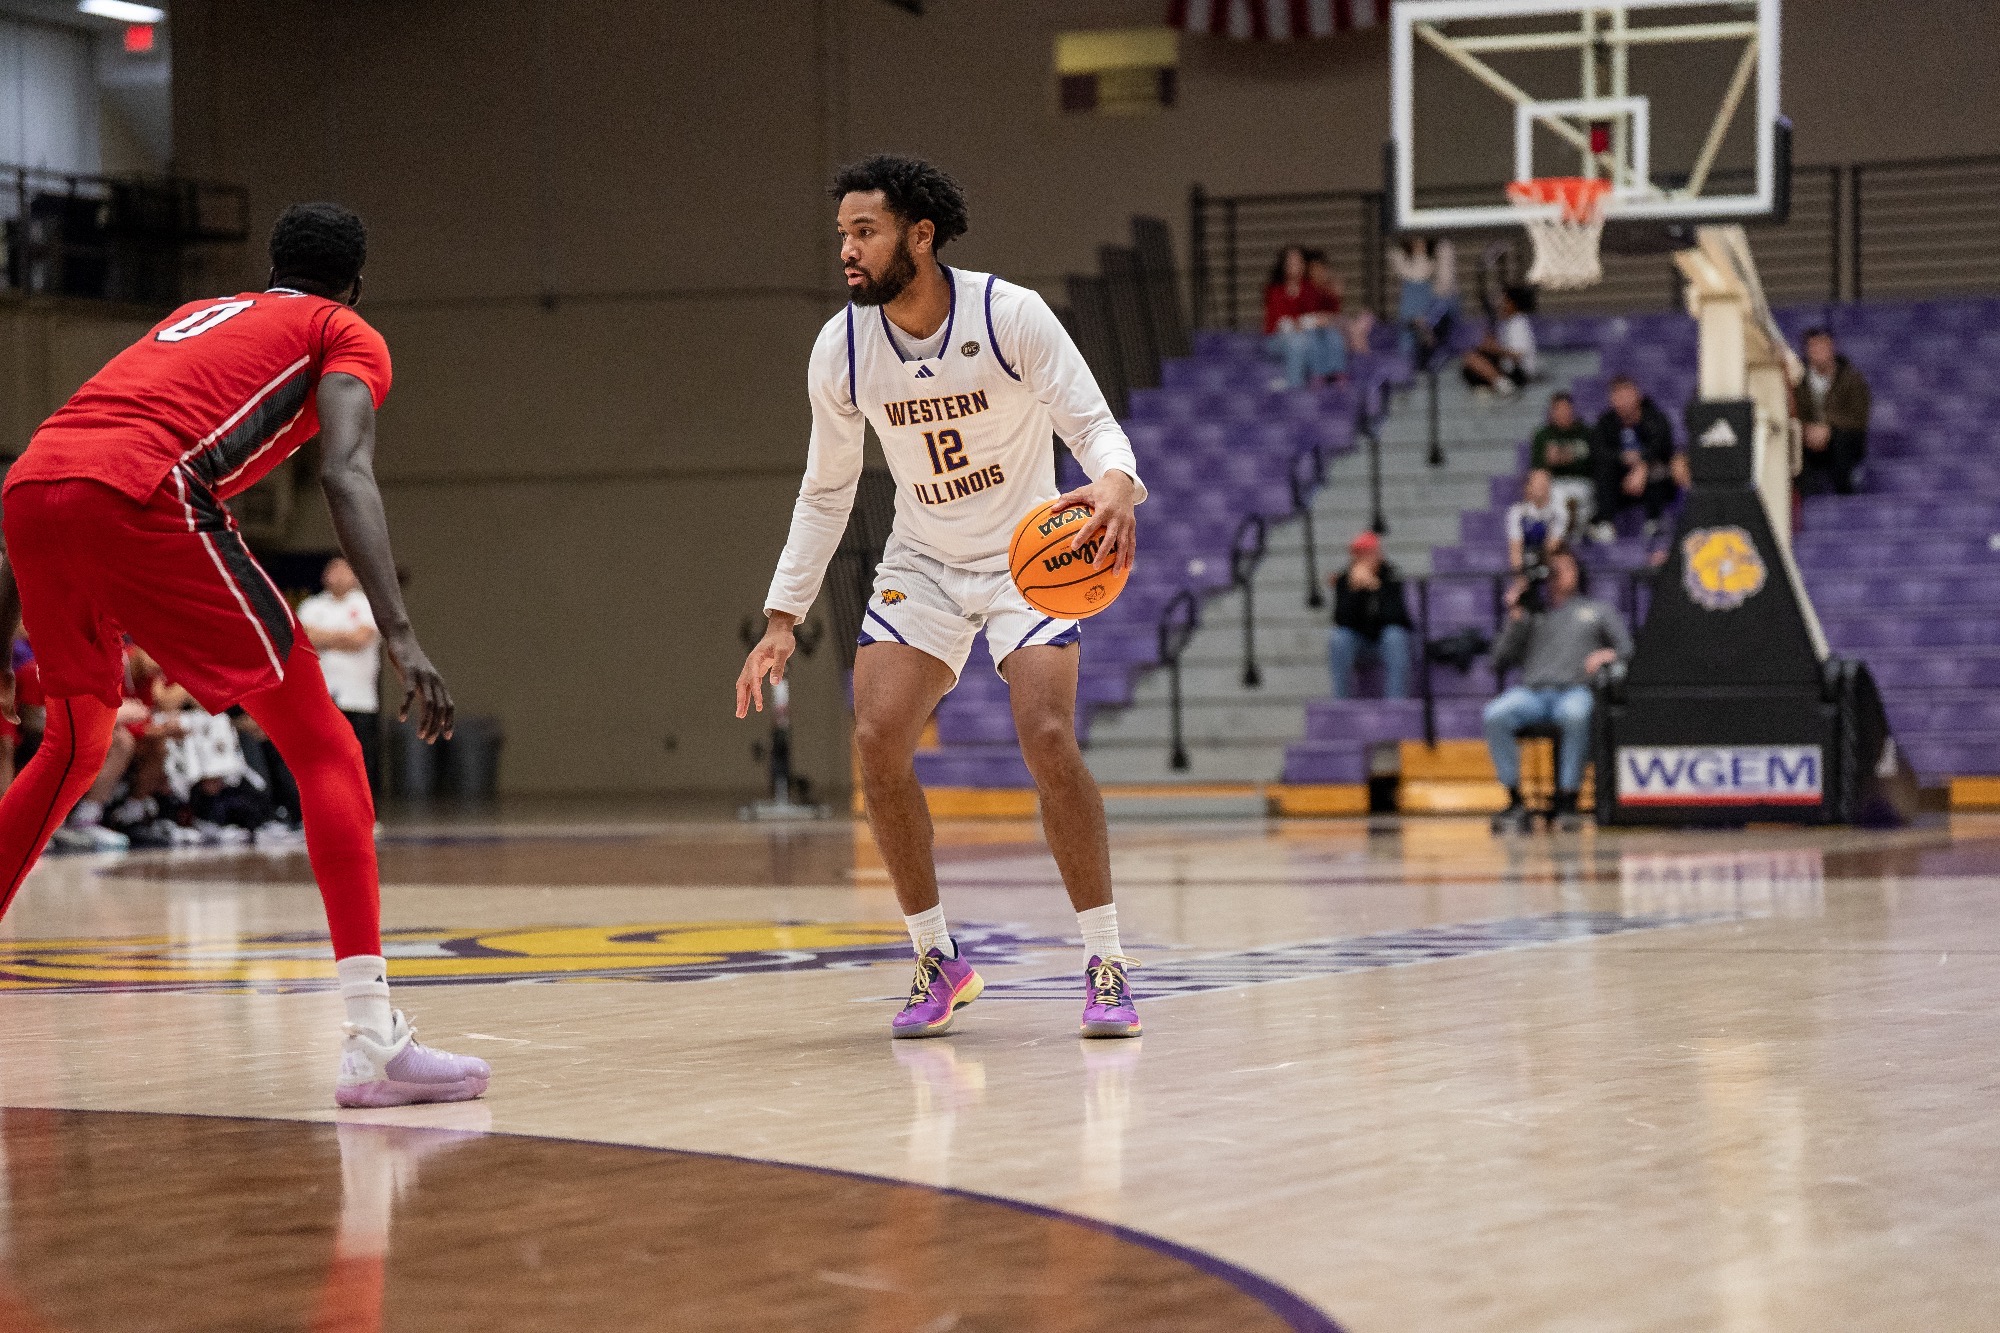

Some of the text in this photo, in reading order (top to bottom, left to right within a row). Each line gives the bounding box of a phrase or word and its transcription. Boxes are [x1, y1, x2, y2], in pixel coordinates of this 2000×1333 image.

[154, 299, 257, 343] 0
[883, 388, 990, 427] WESTERN
[921, 428, 970, 476] 12
[913, 463, 1005, 505] ILLINOIS
[1037, 506, 1093, 538] NCAA
[1628, 754, 1816, 788] WGEM
